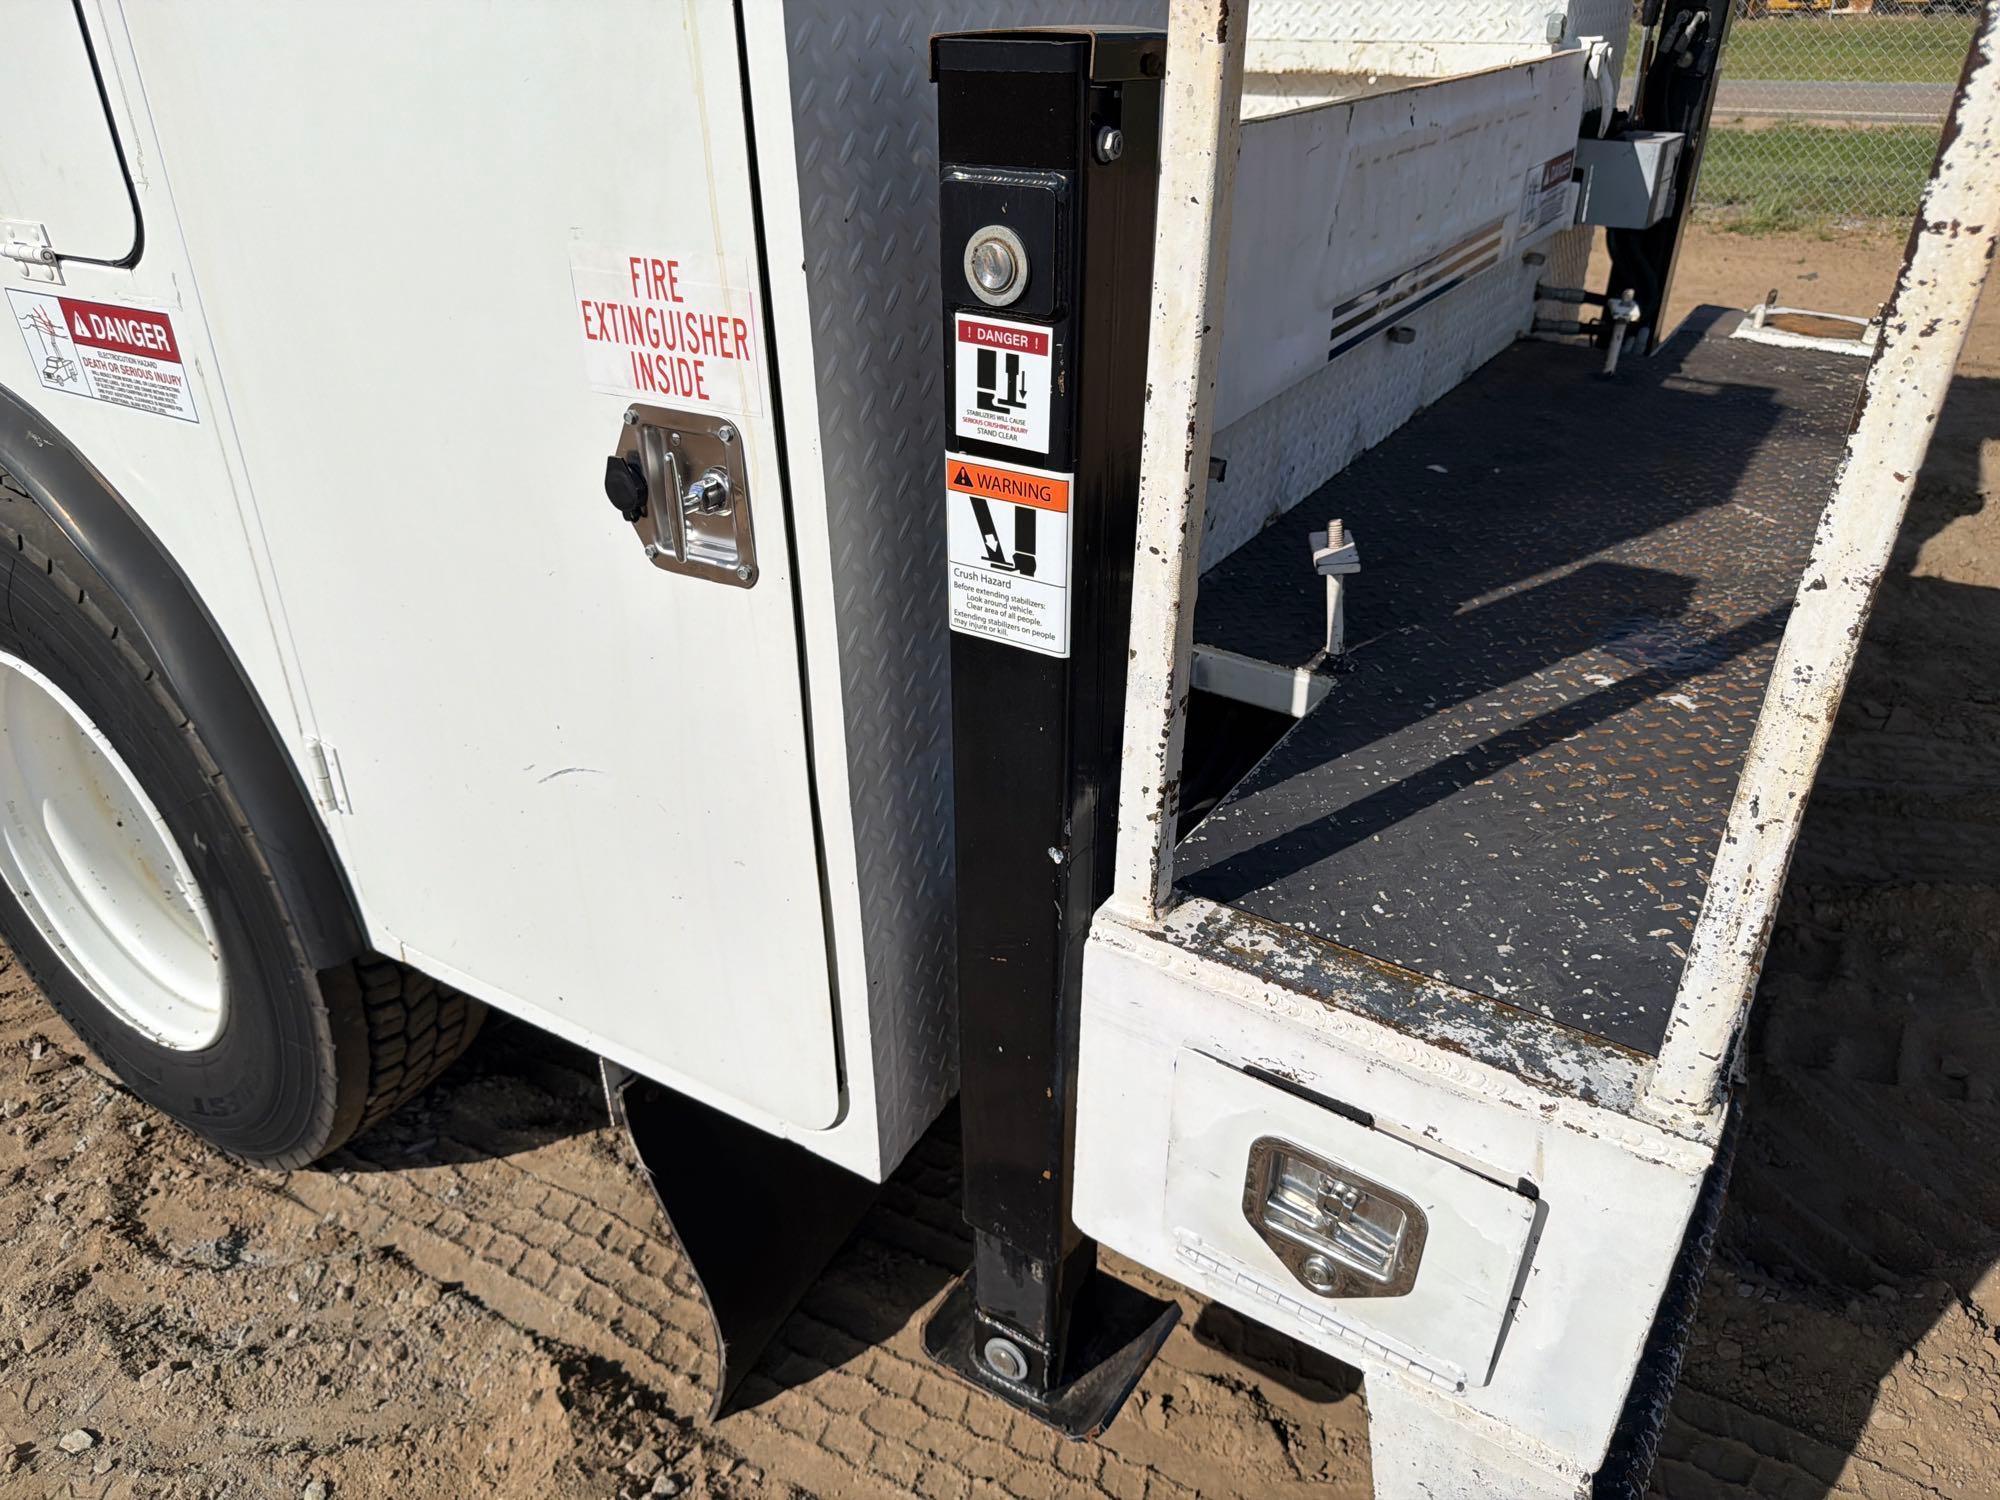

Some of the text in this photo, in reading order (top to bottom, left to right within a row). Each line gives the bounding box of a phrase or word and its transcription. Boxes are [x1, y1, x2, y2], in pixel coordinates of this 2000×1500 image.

[629, 256, 684, 303] FIRE
[89, 313, 171, 352] DANGER
[581, 300, 750, 361] EXTINGUISHER
[977, 328, 1029, 348] DANGER
[82, 357, 109, 372] DEATH
[108, 362, 120, 373] OR
[120, 364, 154, 381] SERIOUS
[153, 371, 182, 387] INJURY
[97, 350, 158, 369] ELECTROCUTION HAZARD
[631, 350, 710, 400] INSIDE
[962, 416, 1029, 434] SERIOUS CRUSHING INJURY
[966, 409, 1026, 426] STABILIZERS WILL CAUSE
[977, 427, 1018, 442] STAND CLEAR
[977, 473, 1051, 502] WARNING
[953, 567, 1012, 589] Crush Hazard
[953, 581, 1046, 610] Before extending stabilizers:
[966, 593, 1034, 616] Look around vehicle.
[953, 609, 1056, 641] Extending stabilizers on people
[966, 602, 1042, 627] Clear area of all people.
[953, 618, 967, 628] may
[968, 619, 988, 631] injure
[997, 626, 1009, 637] kill.
